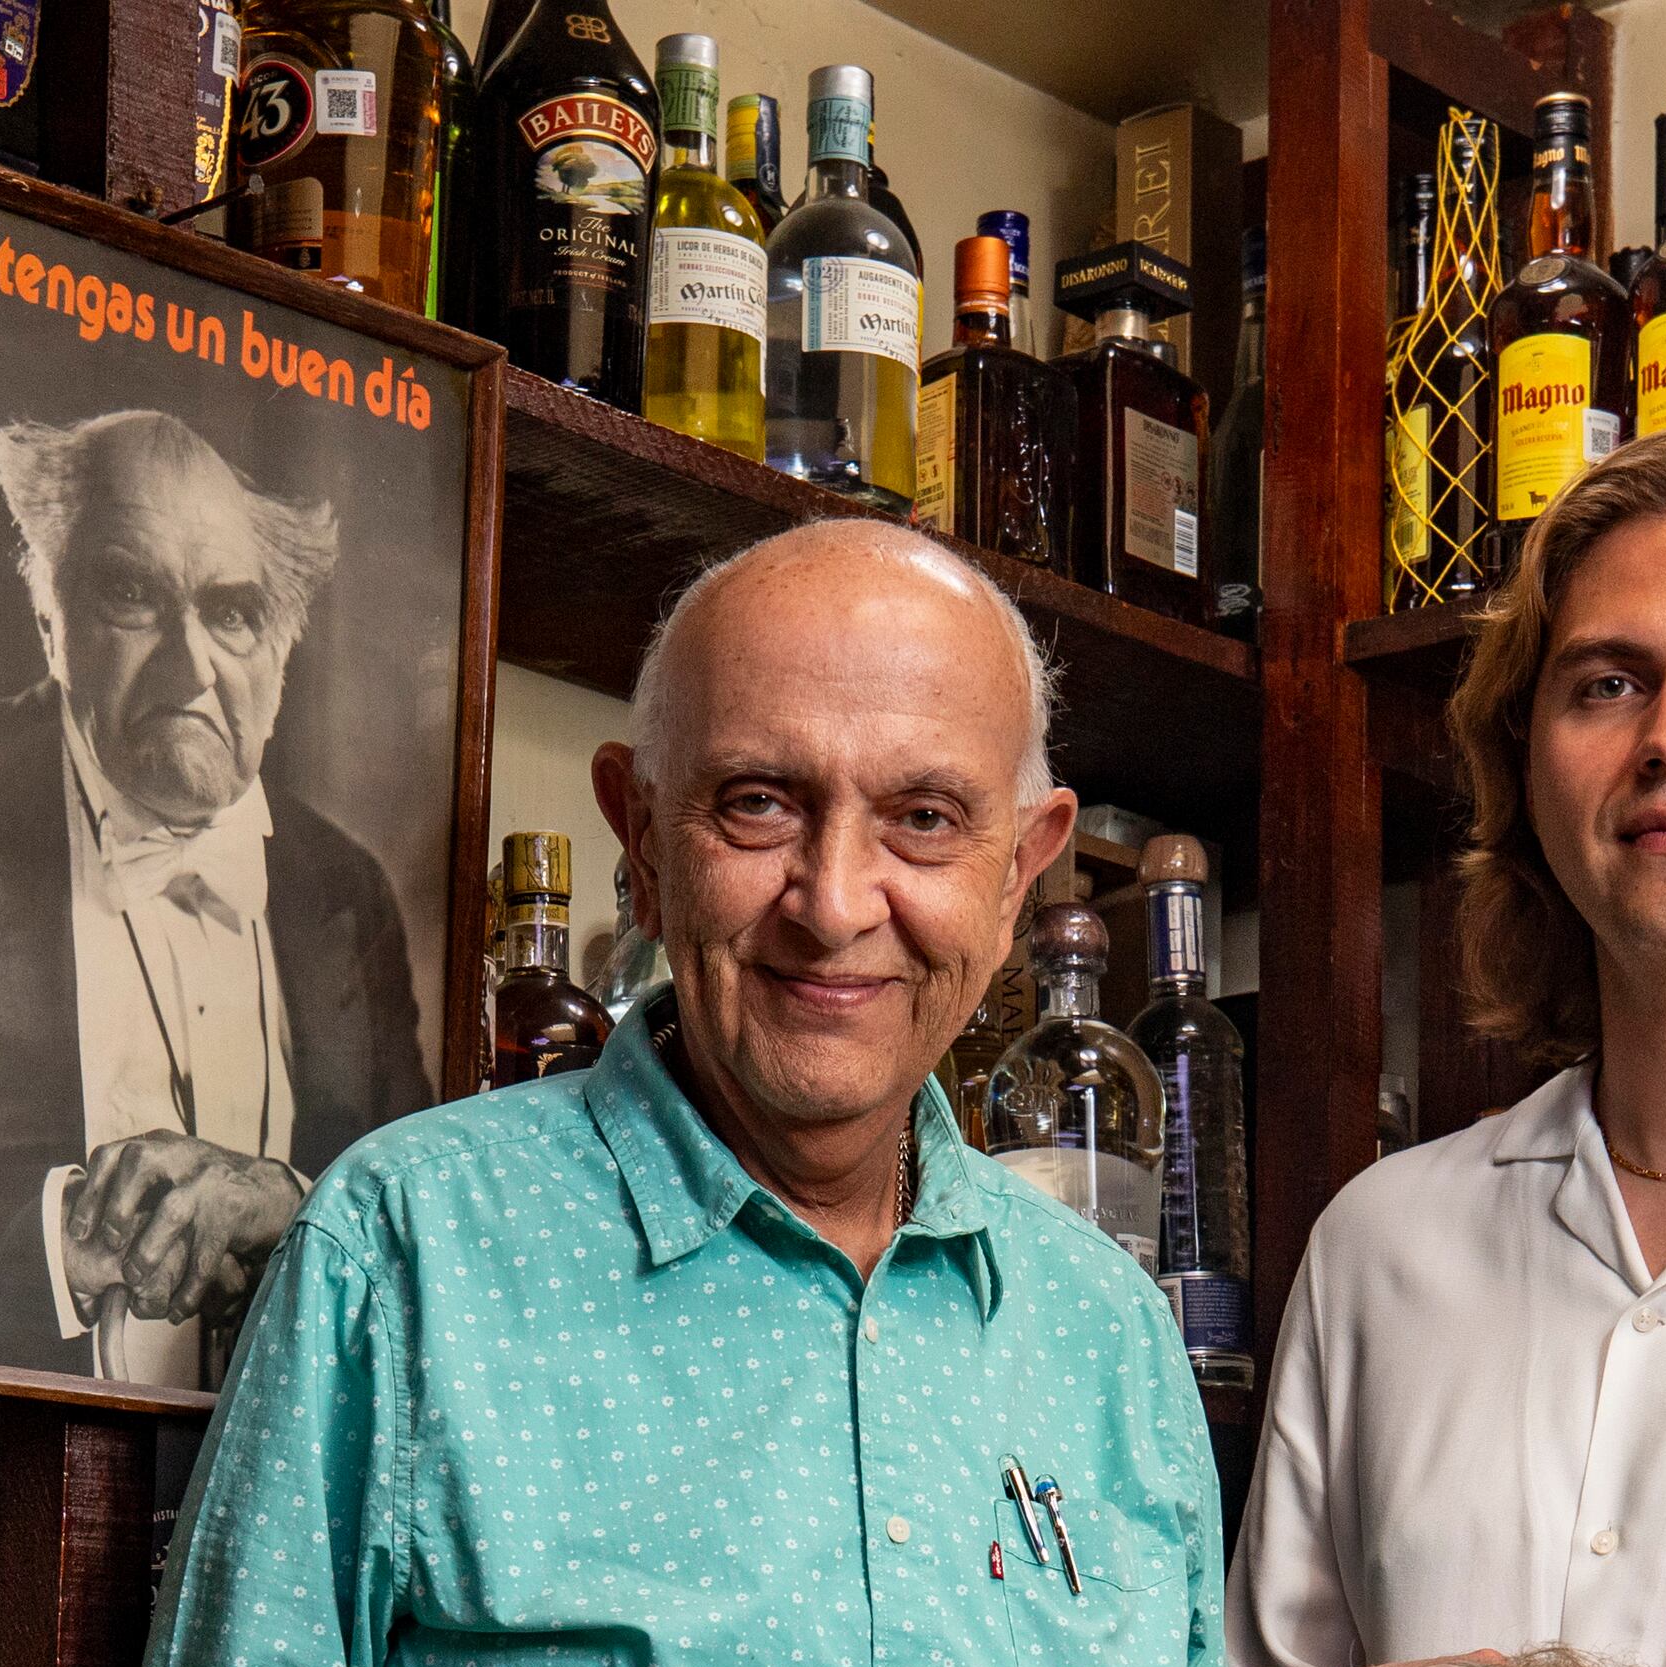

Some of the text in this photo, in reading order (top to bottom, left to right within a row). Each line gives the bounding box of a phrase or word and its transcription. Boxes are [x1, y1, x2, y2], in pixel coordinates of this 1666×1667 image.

[529, 103, 655, 157] BAILEYS
[578, 216, 611, 233] The
[540, 228, 638, 257] ORIGINAL
[553, 246, 627, 267] Irish Cream
[677, 240, 699, 252] LICOR
[702, 242, 711, 252] DE
[713, 243, 739, 260] HERBAS
[858, 270, 900, 291] AUGARDENTE
[1061, 258, 1128, 289] DISARONNO
[680, 281, 745, 310] Martín
[860, 313, 911, 338] Martín
[166, 303, 225, 365] un
[242, 311, 354, 408] buen
[364, 358, 431, 430] día
[1503, 382, 1585, 415] Magno
